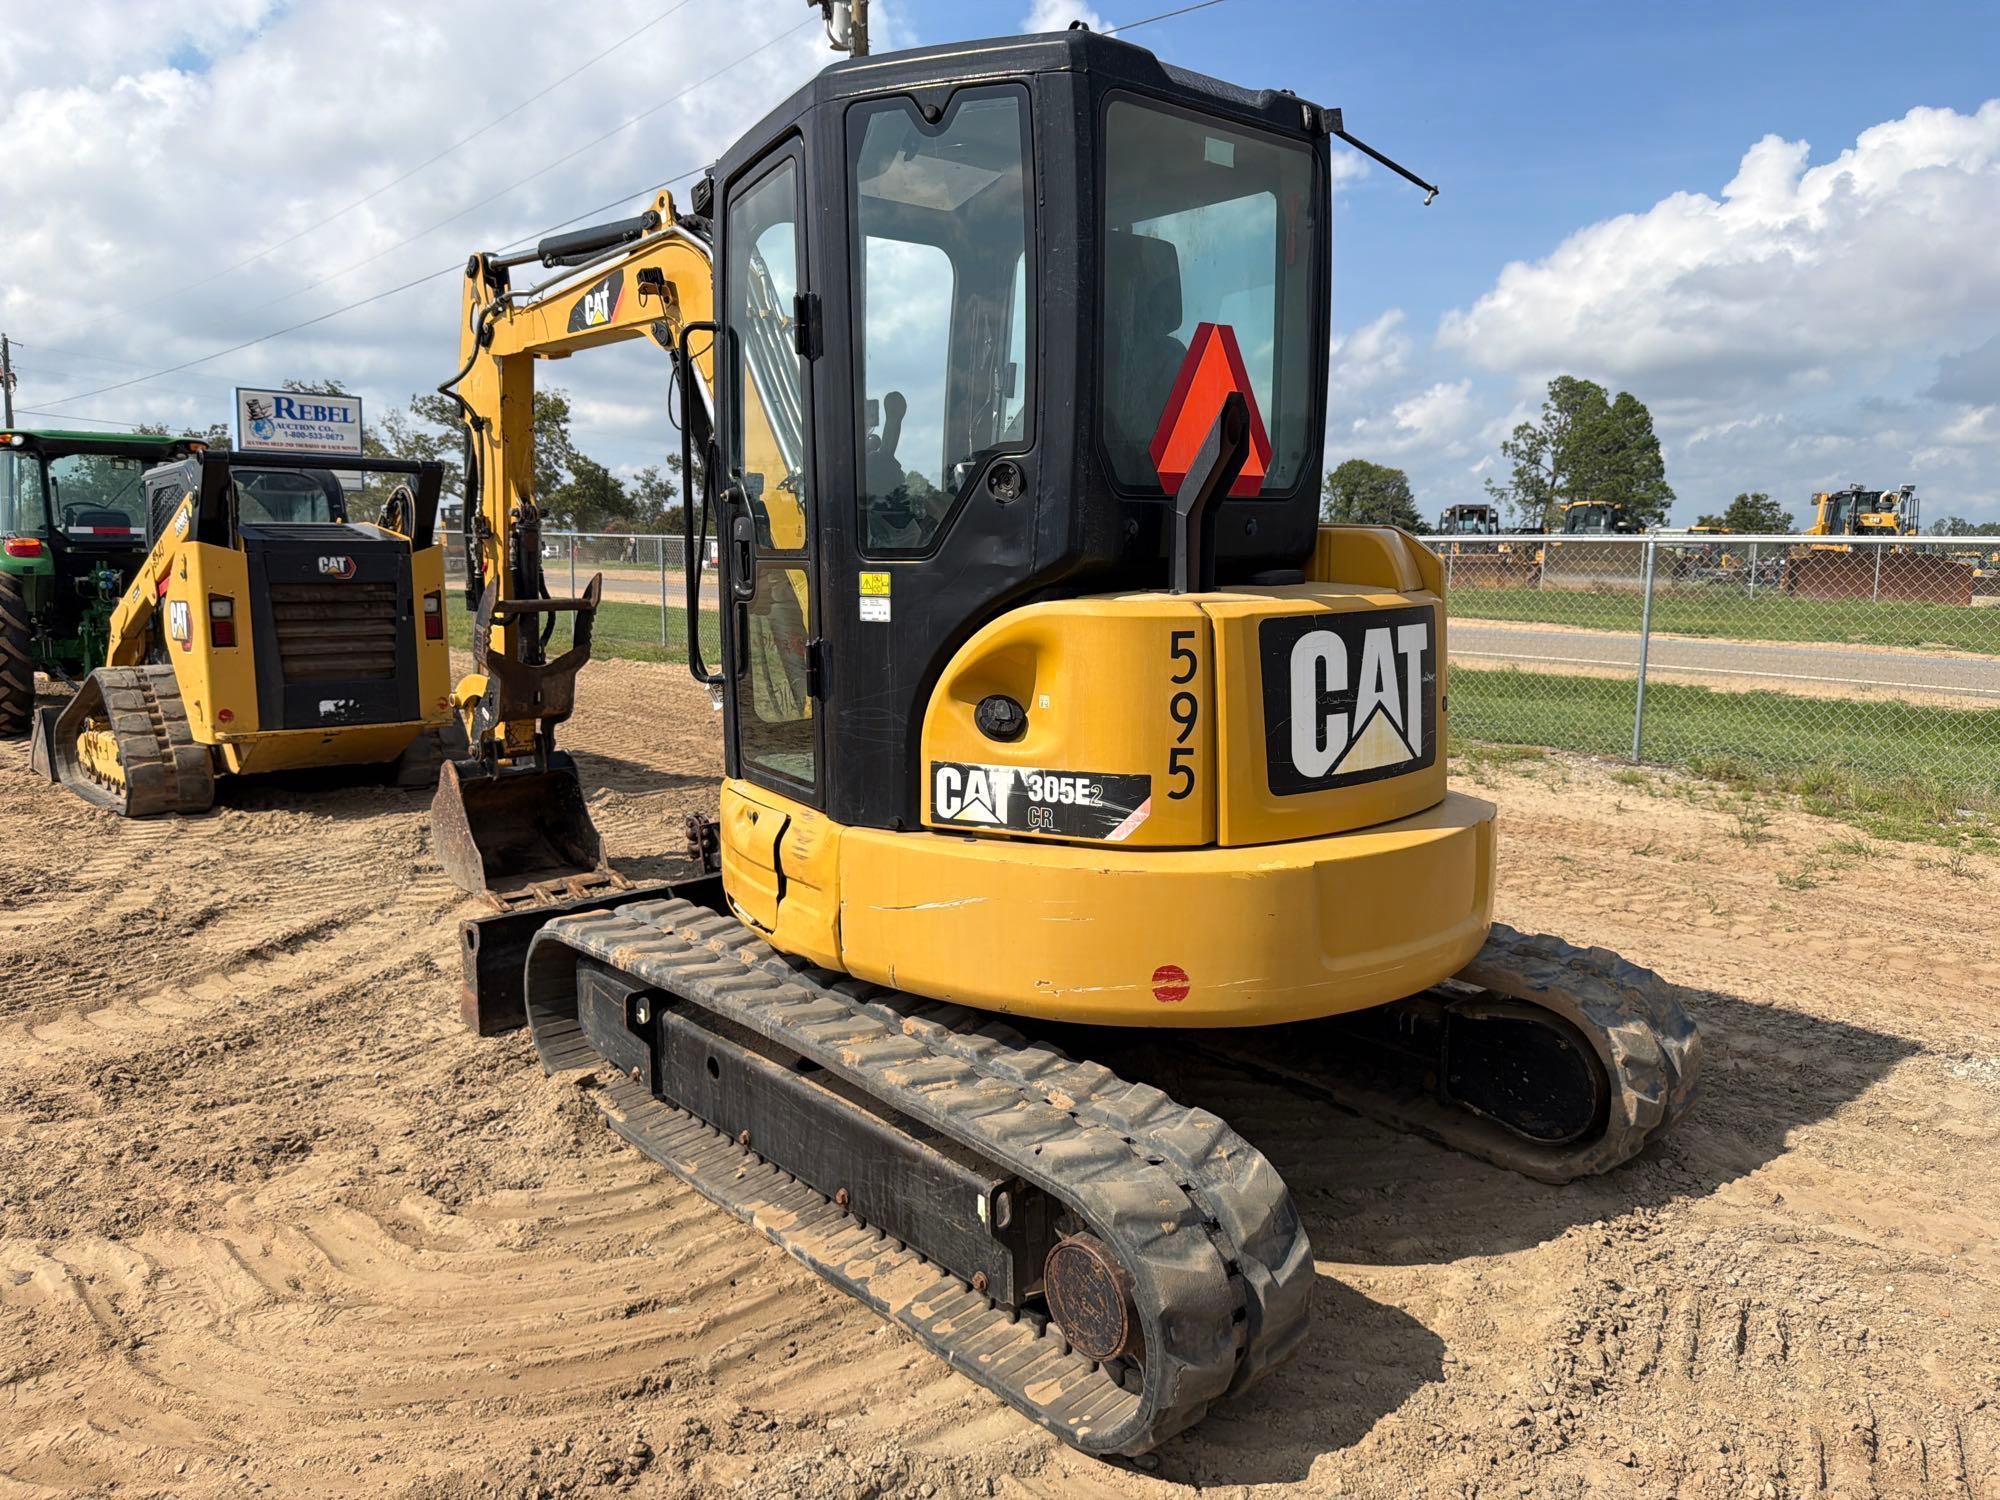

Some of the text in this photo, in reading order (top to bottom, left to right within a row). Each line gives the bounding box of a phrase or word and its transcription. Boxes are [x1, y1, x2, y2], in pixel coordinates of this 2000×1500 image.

[585, 290, 609, 325] CAT
[273, 396, 355, 423] REBEL
[275, 423, 316, 431] AUCTION
[318, 556, 346, 573] CAT
[170, 601, 188, 639] CAT
[1290, 623, 1427, 778] CAT
[936, 766, 1103, 824] CAT 305E2
[1027, 806, 1054, 828] CR
